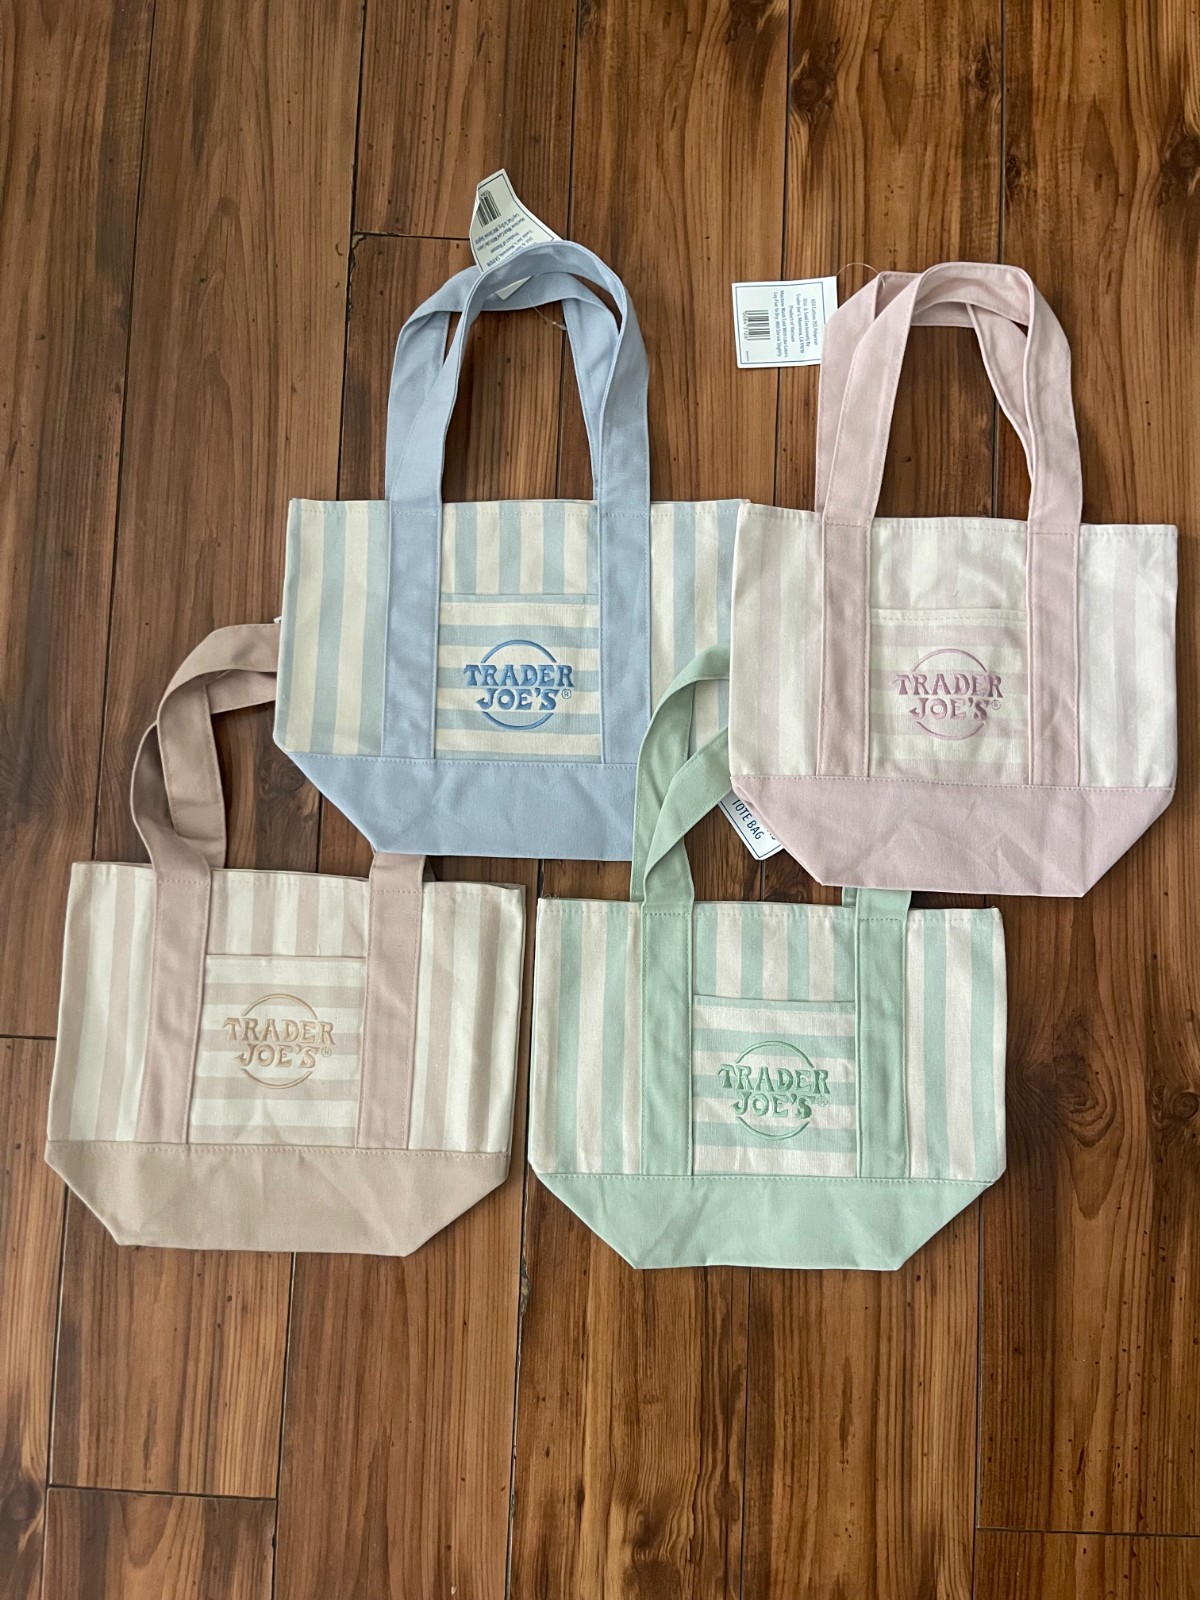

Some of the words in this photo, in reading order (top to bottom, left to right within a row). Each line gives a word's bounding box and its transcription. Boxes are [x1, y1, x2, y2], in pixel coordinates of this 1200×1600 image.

[463, 664, 575, 687] TRADER
[893, 673, 1003, 698] TRADER
[732, 799, 753, 822] TOTE
[746, 819, 765, 840] BAG
[223, 1017, 336, 1045] TRADER
[717, 1063, 831, 1094] TRADER
